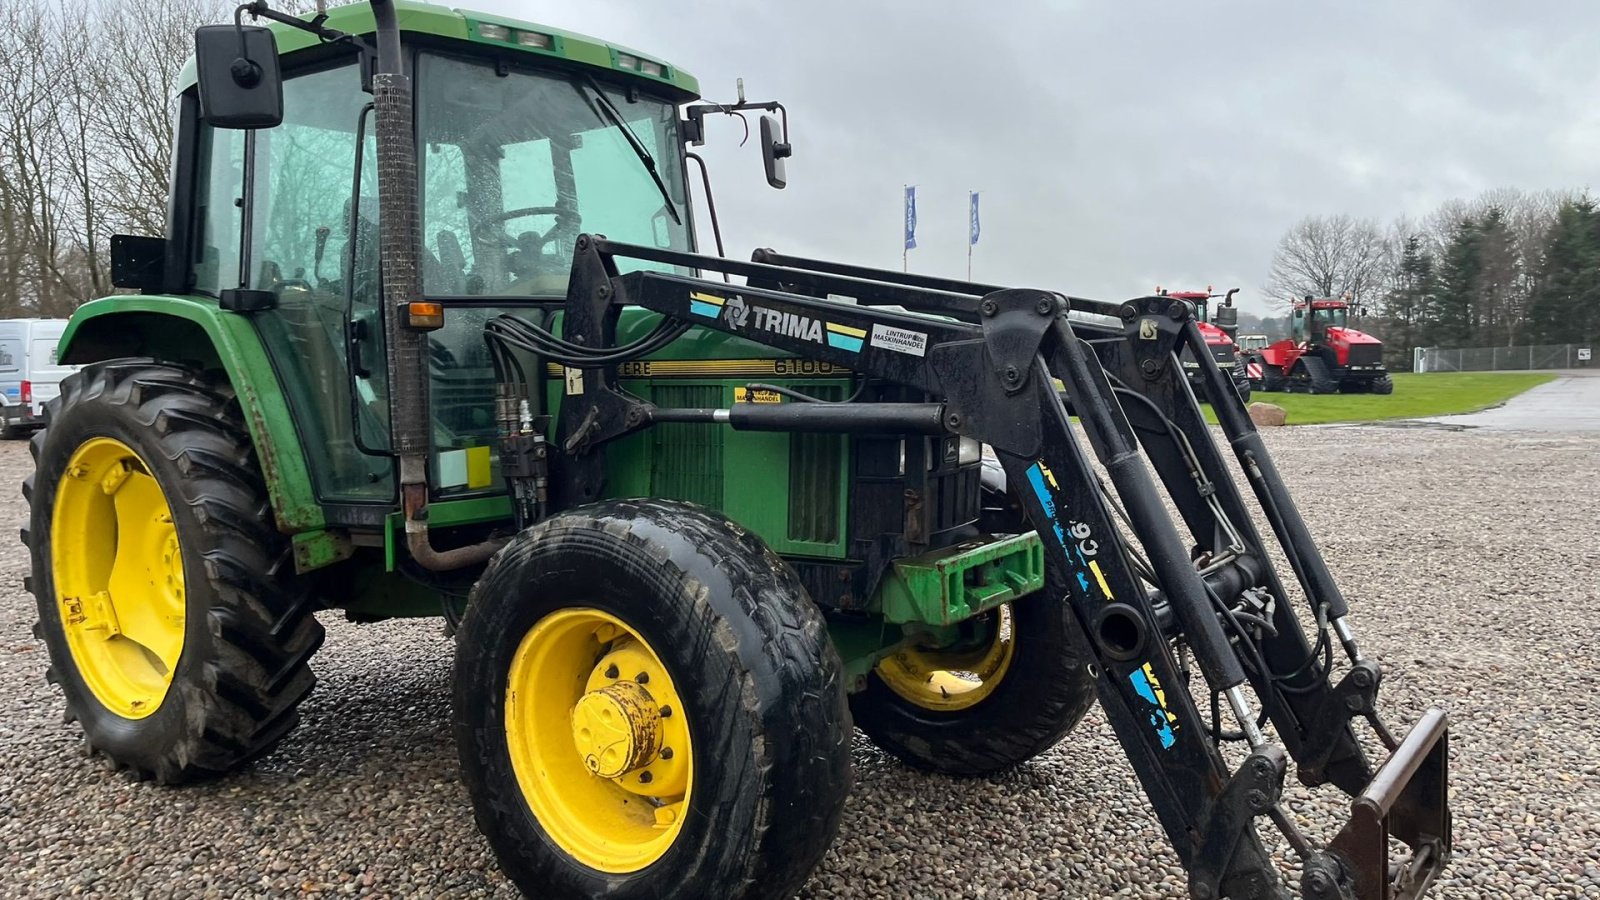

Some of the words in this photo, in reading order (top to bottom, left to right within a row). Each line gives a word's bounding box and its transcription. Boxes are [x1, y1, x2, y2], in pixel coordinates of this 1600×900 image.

[752, 306, 823, 344] TRIMA
[873, 334, 923, 349] MASKINHANDEL
[886, 330, 912, 340] LINTRUP
[623, 361, 651, 376] ERE
[775, 360, 833, 375] 6100
